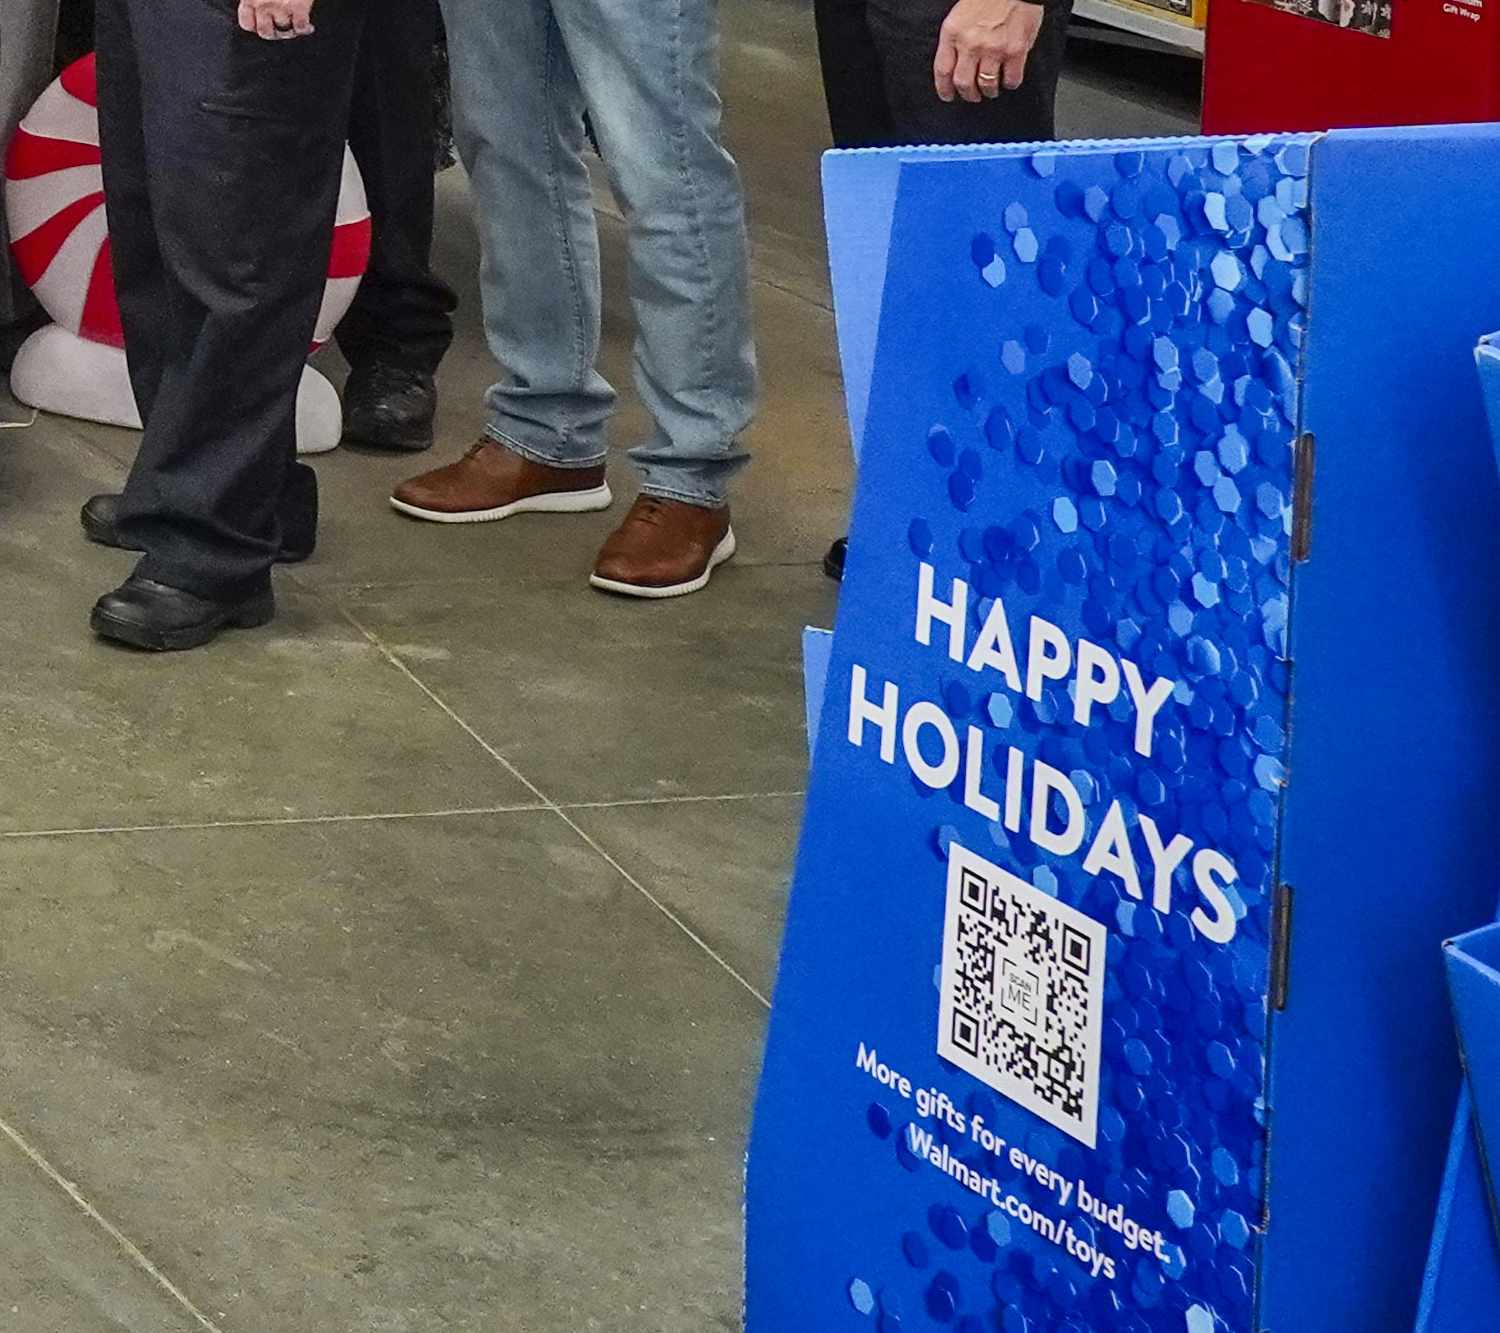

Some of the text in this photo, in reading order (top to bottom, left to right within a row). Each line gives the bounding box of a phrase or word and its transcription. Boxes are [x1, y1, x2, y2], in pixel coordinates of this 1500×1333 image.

[1442, 2, 1481, 23] Gift Wrap
[915, 562, 1176, 758] HAPPY
[846, 664, 1239, 945] HOLIDAYS
[1007, 986, 1032, 1013] ME
[1008, 971, 1033, 995] SCAN
[855, 1041, 1171, 1264] More gifts for every budget.
[907, 1123, 1118, 1282] Walmart.com/toys
